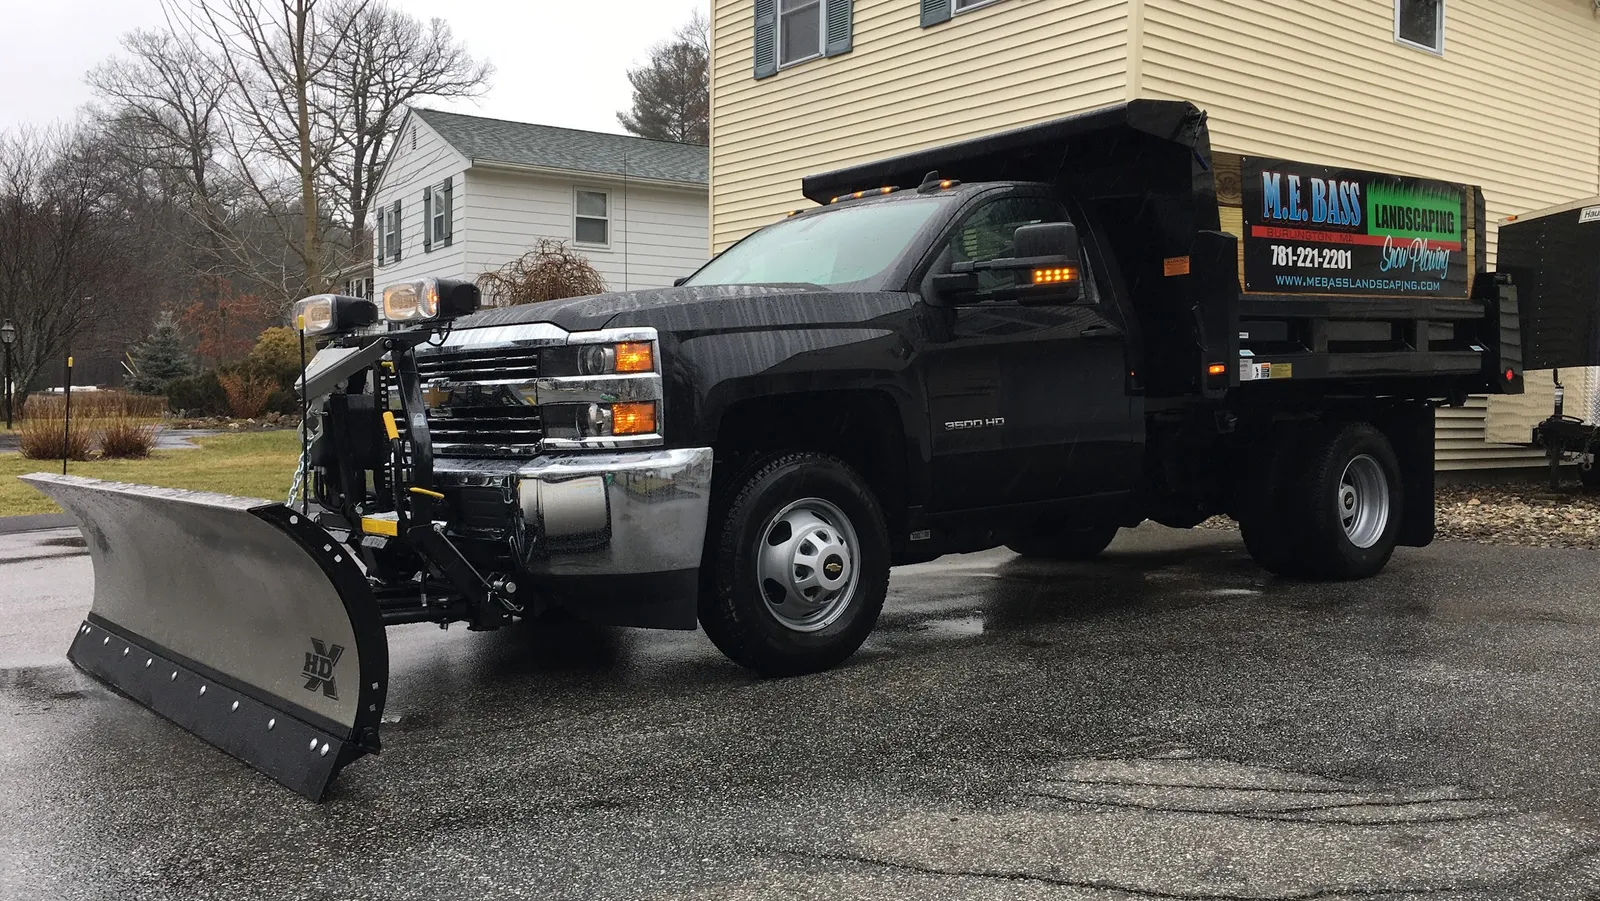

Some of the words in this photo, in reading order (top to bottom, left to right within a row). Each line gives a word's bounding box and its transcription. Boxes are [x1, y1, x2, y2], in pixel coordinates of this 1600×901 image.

[1262, 171, 1309, 222] M.E.
[1310, 177, 1361, 227] BASS
[1375, 203, 1455, 235] LANDSCAPING
[1270, 244, 1352, 270] 781-221-2201
[1380, 234, 1410, 272] Snow
[1408, 237, 1450, 280] Plowing
[1275, 275, 1440, 291] WWW.MEBASSLANDSCAPING.COM
[944, 419, 983, 431] 3500
[985, 417, 1005, 427] HD
